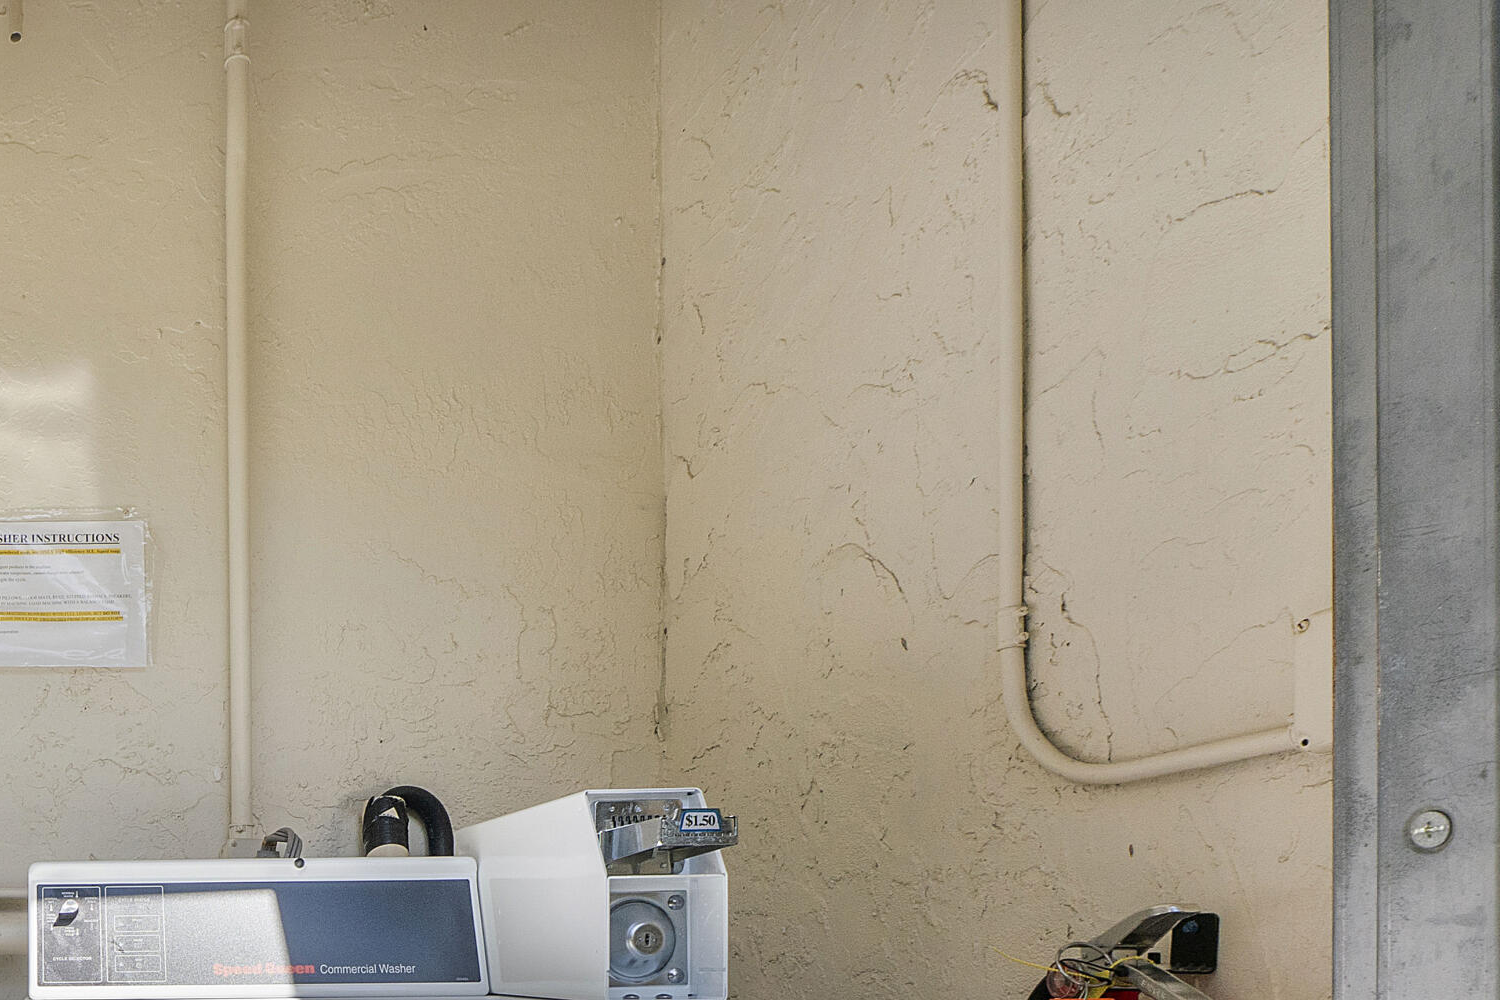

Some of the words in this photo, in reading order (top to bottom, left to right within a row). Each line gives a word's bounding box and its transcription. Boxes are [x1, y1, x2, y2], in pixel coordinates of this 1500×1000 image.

[31, 533, 120, 543] INSTRUCTIONS
[685, 814, 716, 827] $1.50
[213, 963, 264, 976] Speed
[265, 963, 316, 975] Queen
[320, 964, 377, 974] Commercial
[379, 963, 416, 974] Washer
